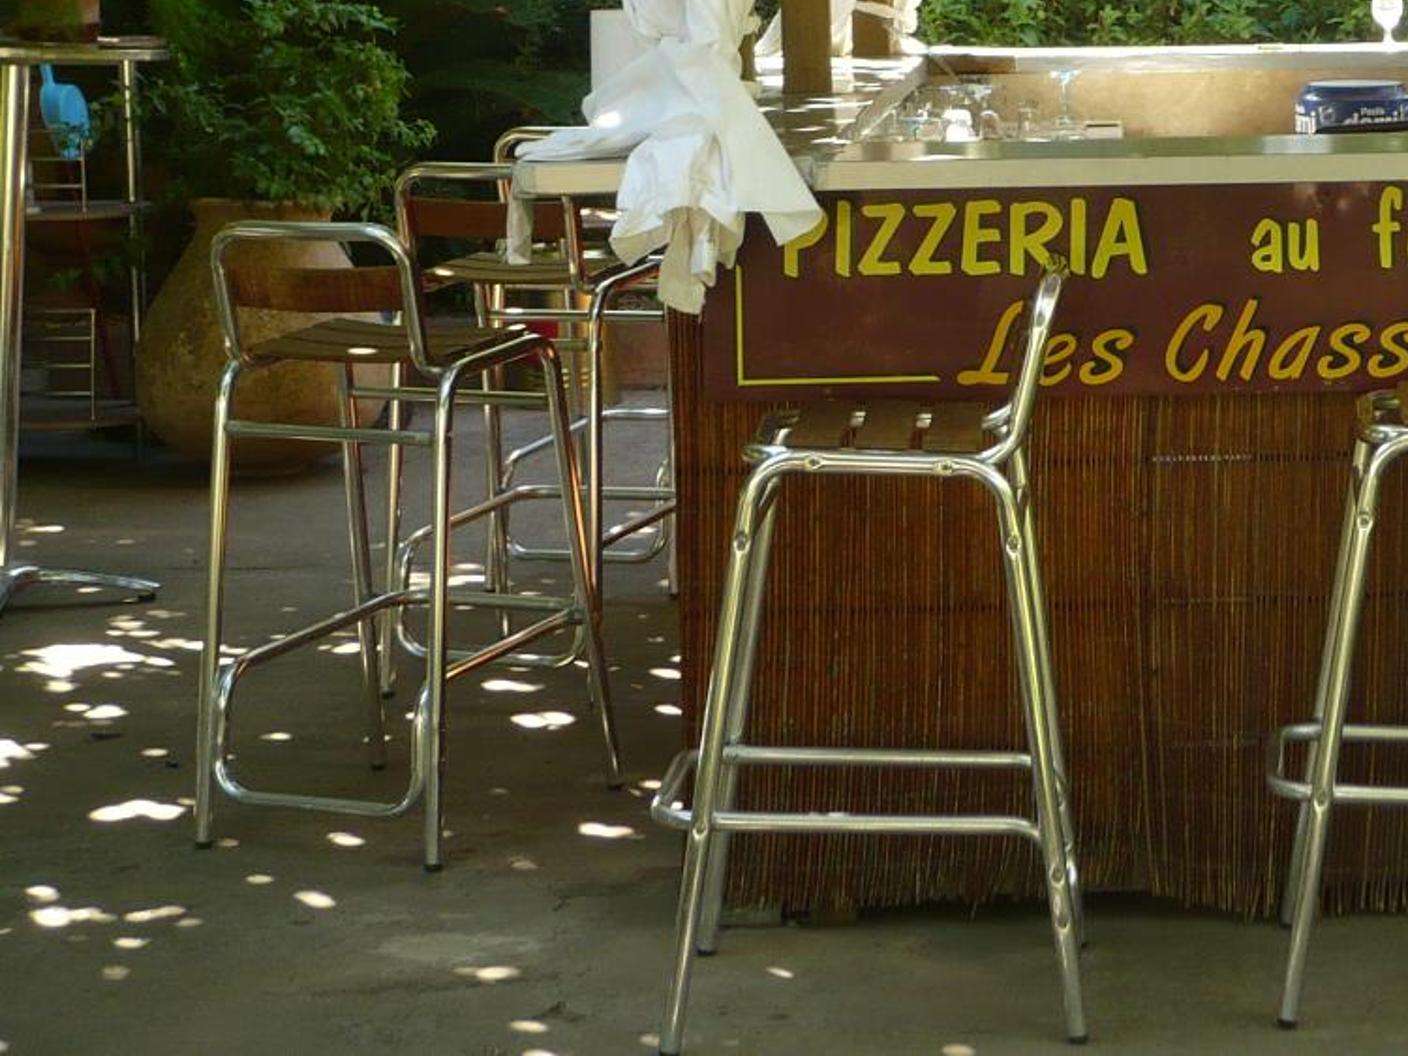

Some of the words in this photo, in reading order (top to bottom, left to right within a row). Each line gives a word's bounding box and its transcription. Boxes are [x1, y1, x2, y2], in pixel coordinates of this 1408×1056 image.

[783, 198, 1149, 278] PIZZERIA
[1251, 217, 1320, 274] au
[957, 300, 1135, 386] Les
